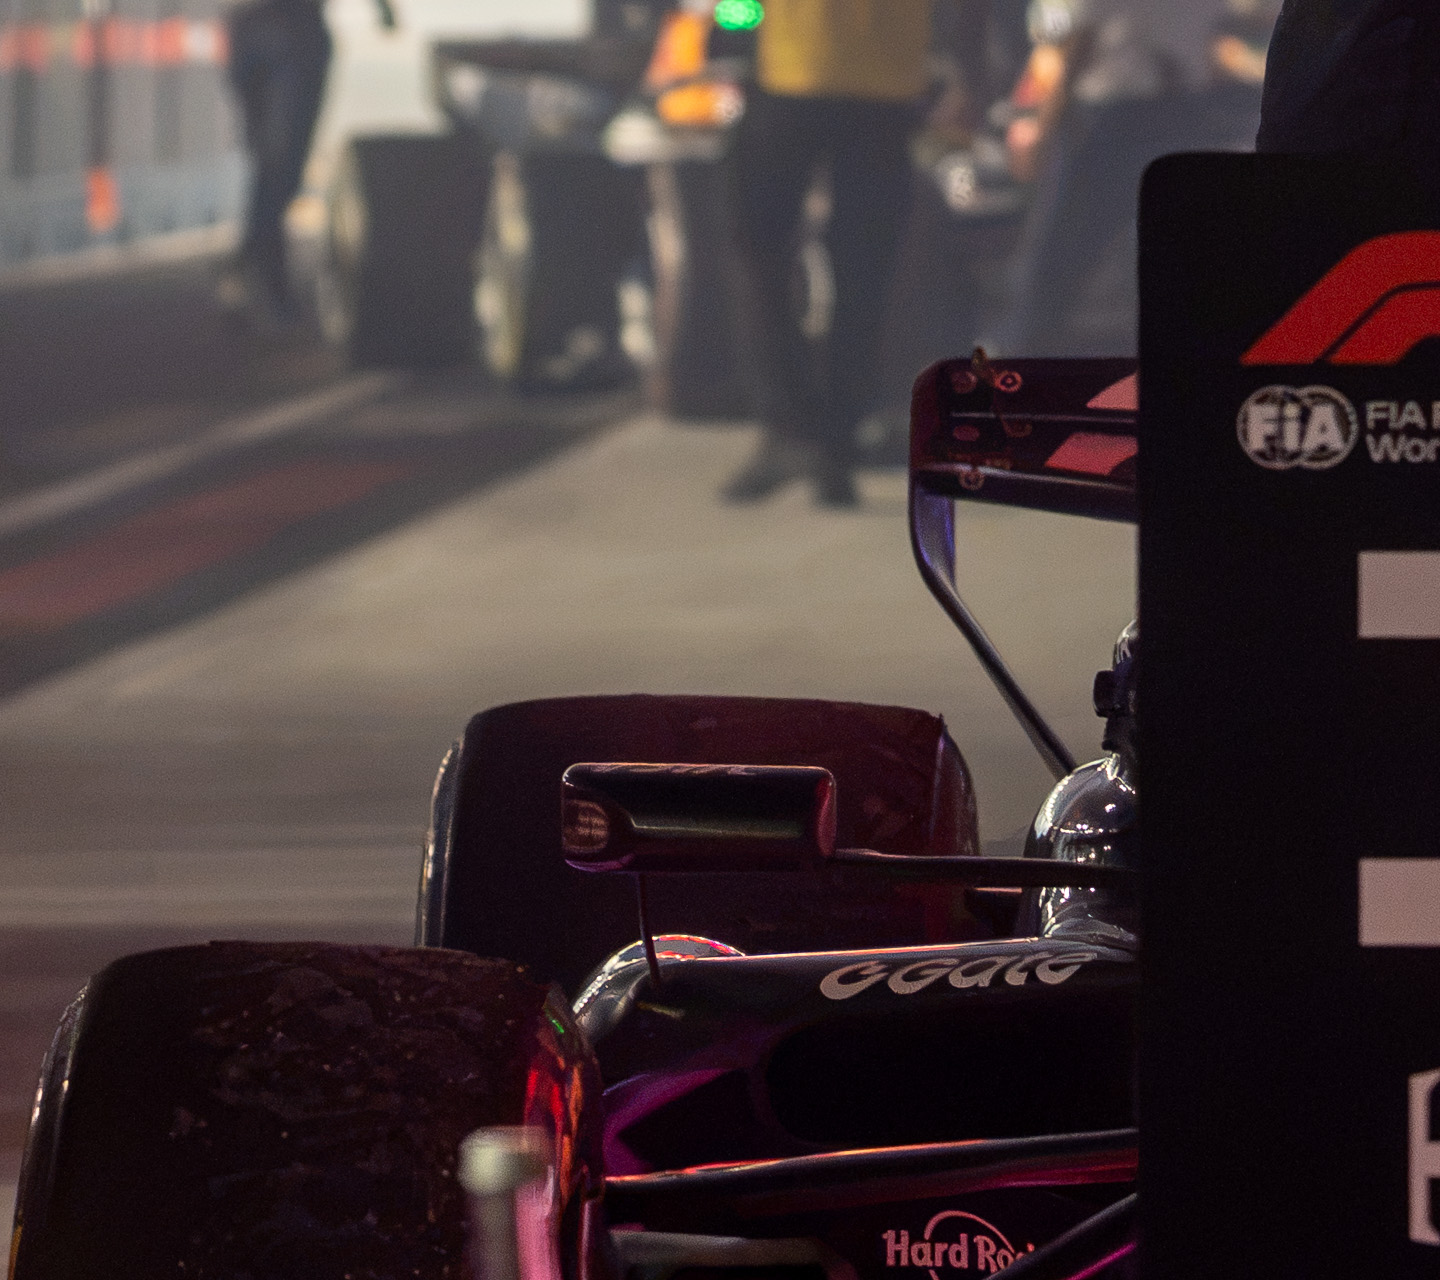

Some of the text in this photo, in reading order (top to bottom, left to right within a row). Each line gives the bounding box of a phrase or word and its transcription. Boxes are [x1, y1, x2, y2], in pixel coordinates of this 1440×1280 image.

[1366, 400, 1427, 431] FIA
[881, 1229, 1035, 1274] Hard Ro
